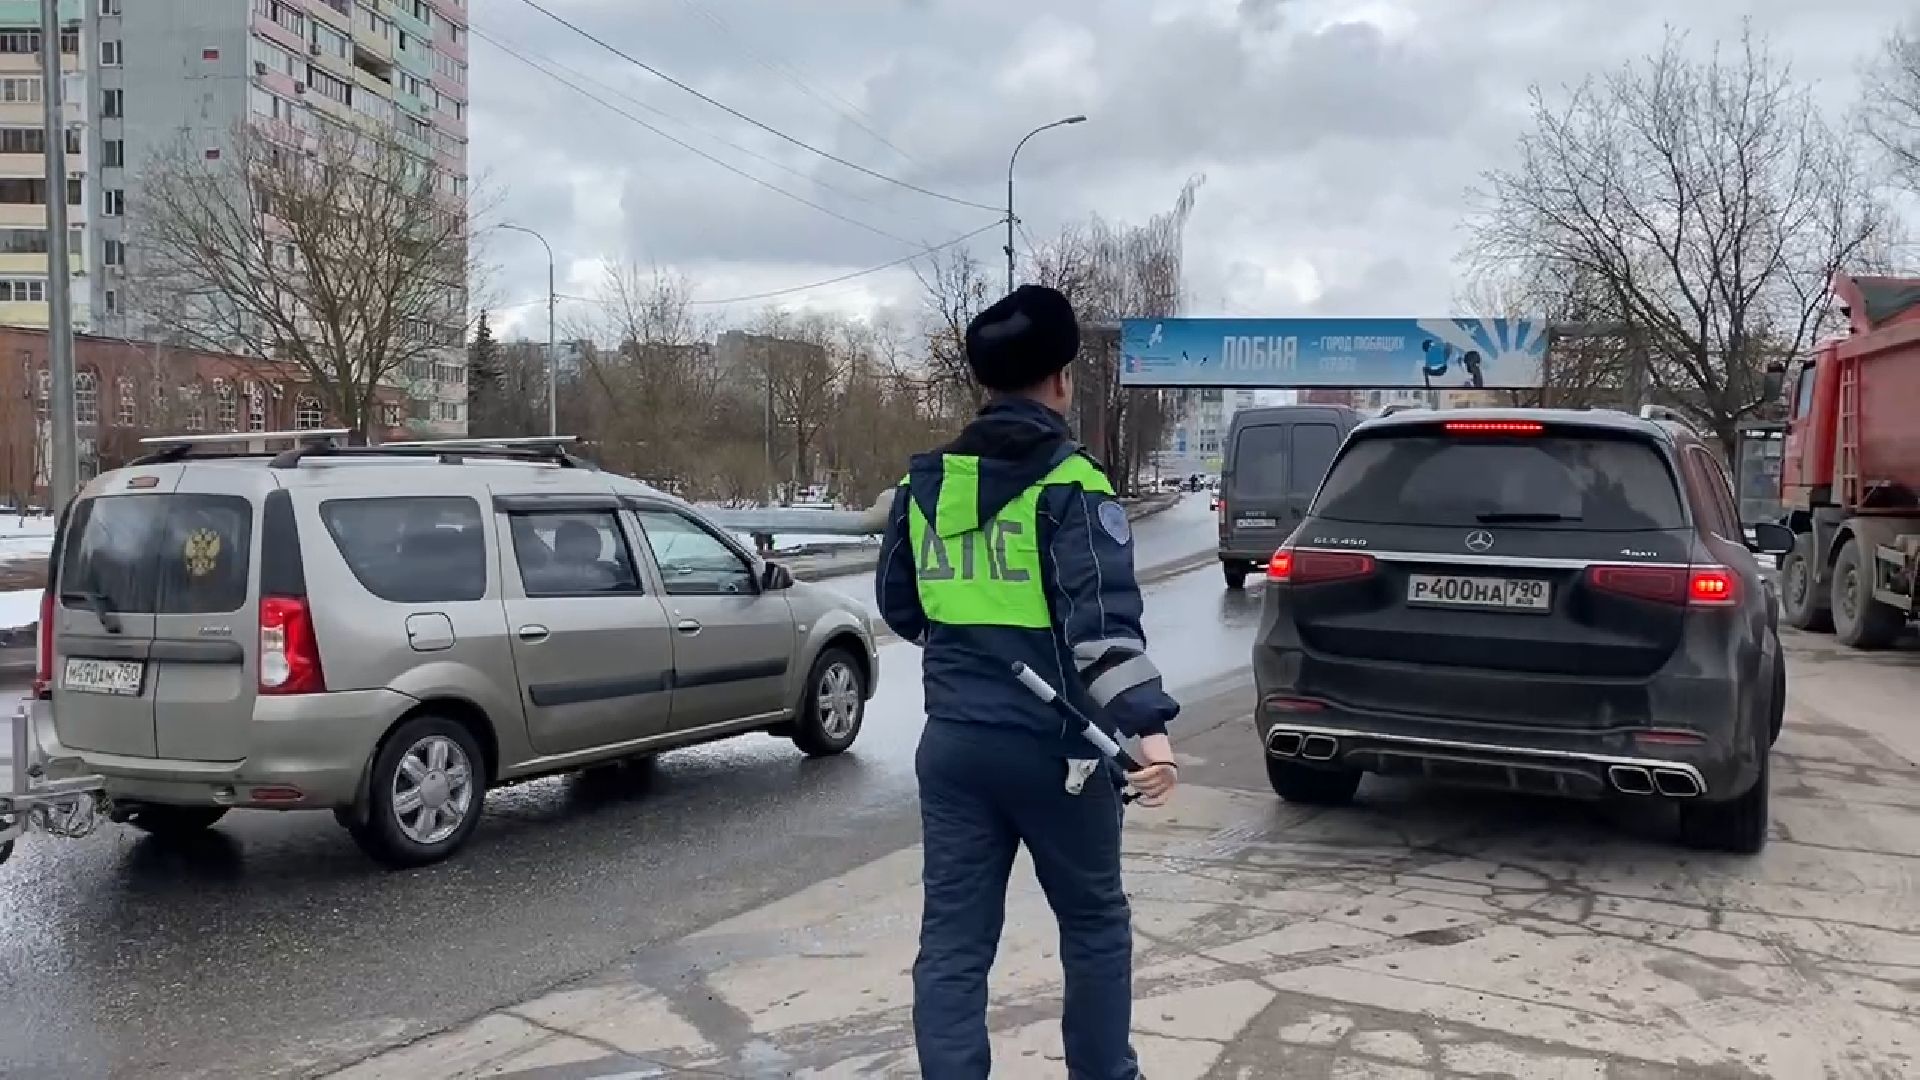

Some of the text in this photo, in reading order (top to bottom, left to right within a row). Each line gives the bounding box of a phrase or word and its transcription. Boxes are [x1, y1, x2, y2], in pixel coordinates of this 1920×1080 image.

[1221, 335, 1298, 370] ЛОБНЯ
[918, 518, 1031, 582] ДПС
[1414, 578, 1543, 602] Р400НА 790
